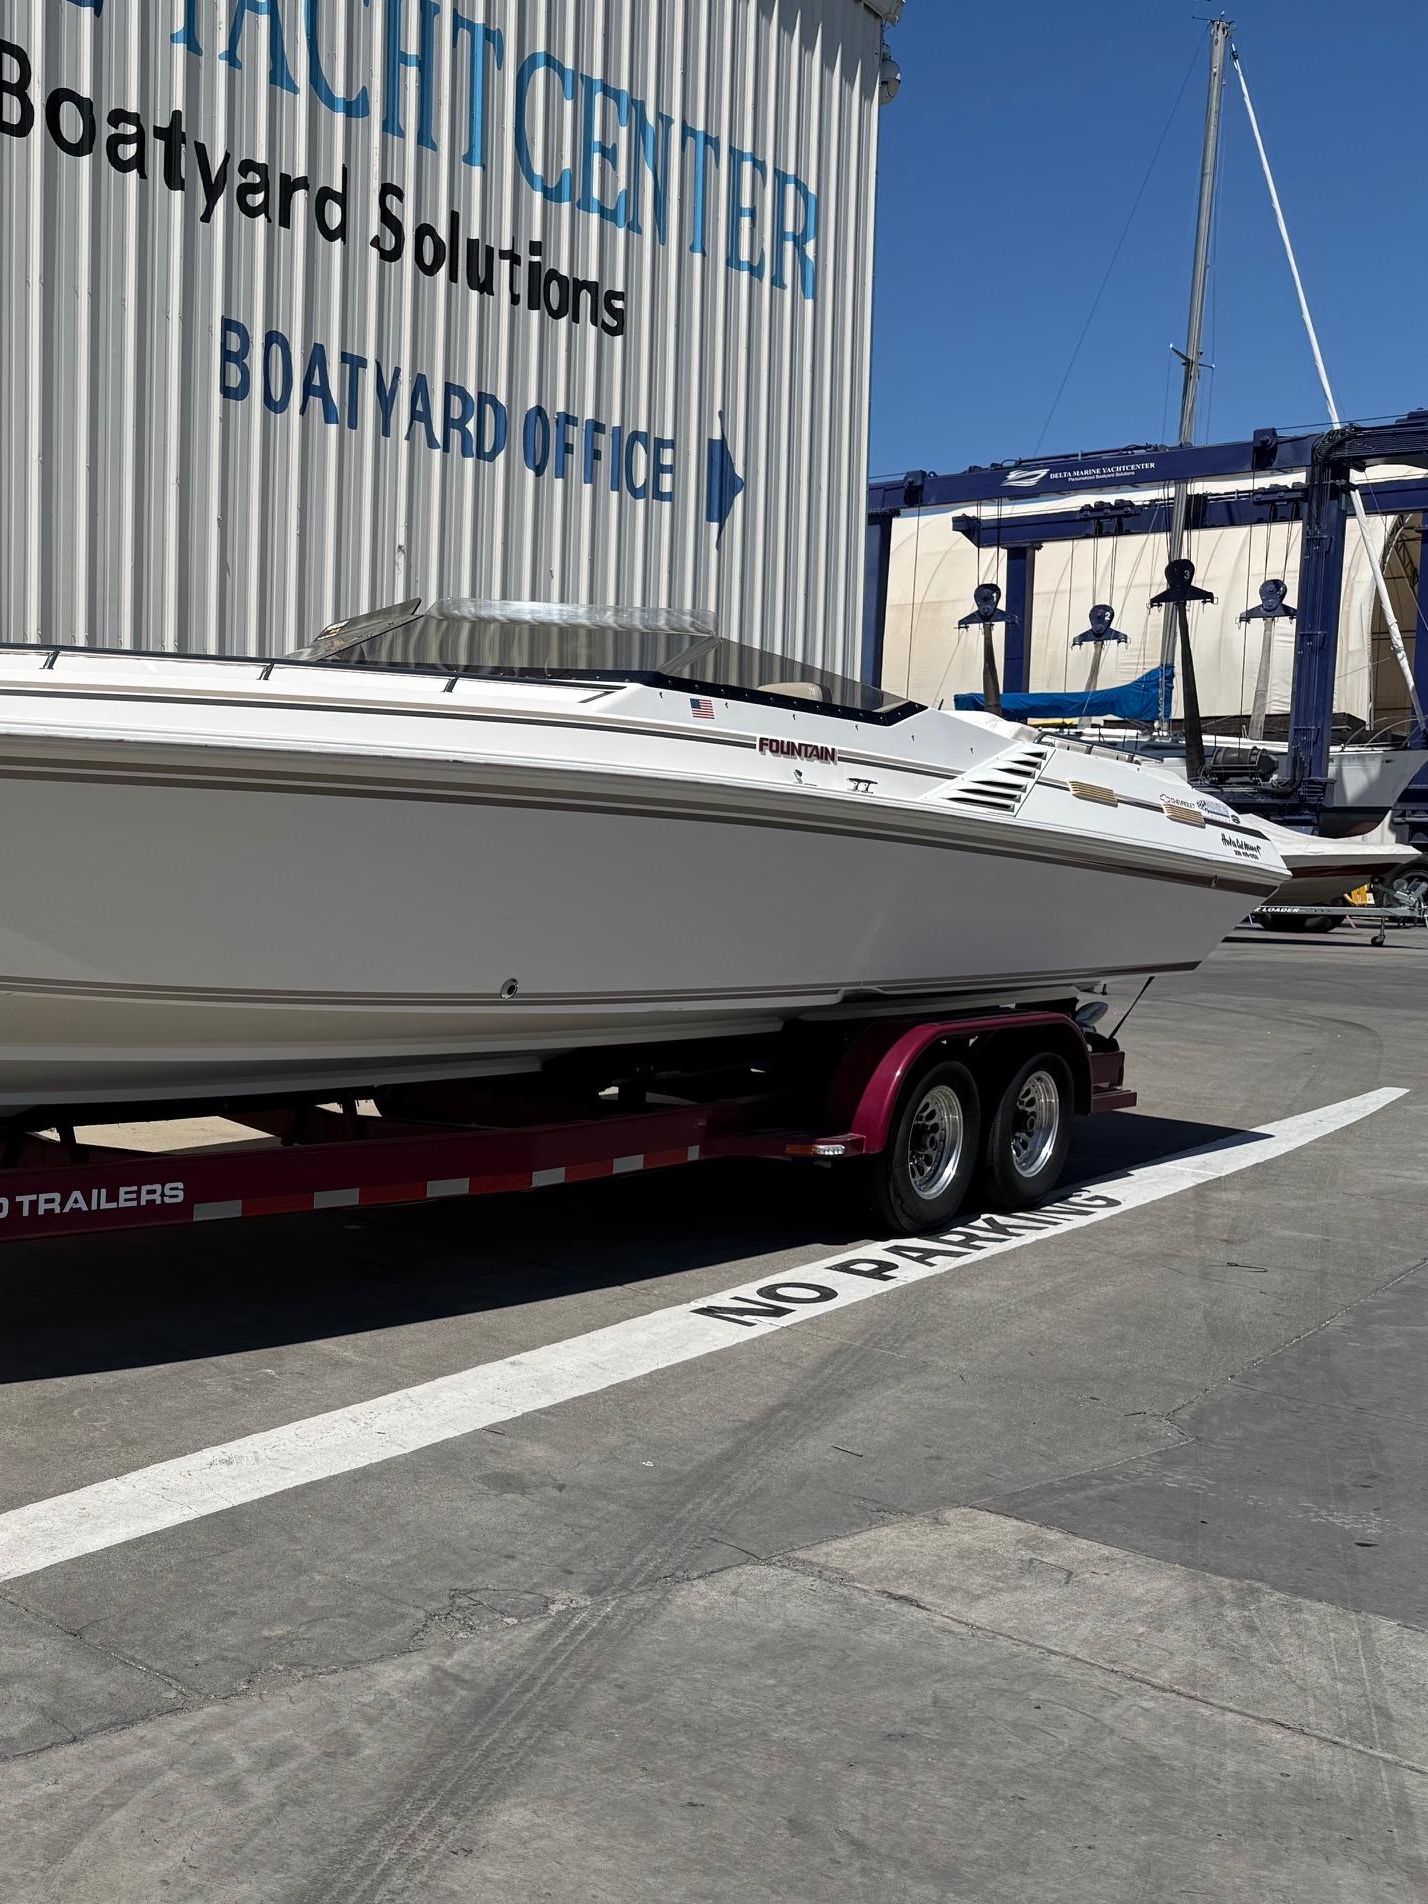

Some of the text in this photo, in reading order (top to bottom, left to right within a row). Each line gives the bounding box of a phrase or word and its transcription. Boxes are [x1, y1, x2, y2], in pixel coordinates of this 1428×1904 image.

[370, 183, 625, 337] Solutions
[220, 315, 675, 503] BOATYARD OFFICE
[1050, 462, 1155, 480] DELTA MARINE YACHTCENTER
[1183, 570, 1190, 580] 3
[1104, 611, 1111, 621] 2
[758, 737, 838, 765] FOUNTAIN
[15, 1181, 185, 1218] TRAILERS
[689, 1190, 1123, 1327] NO PARKING
